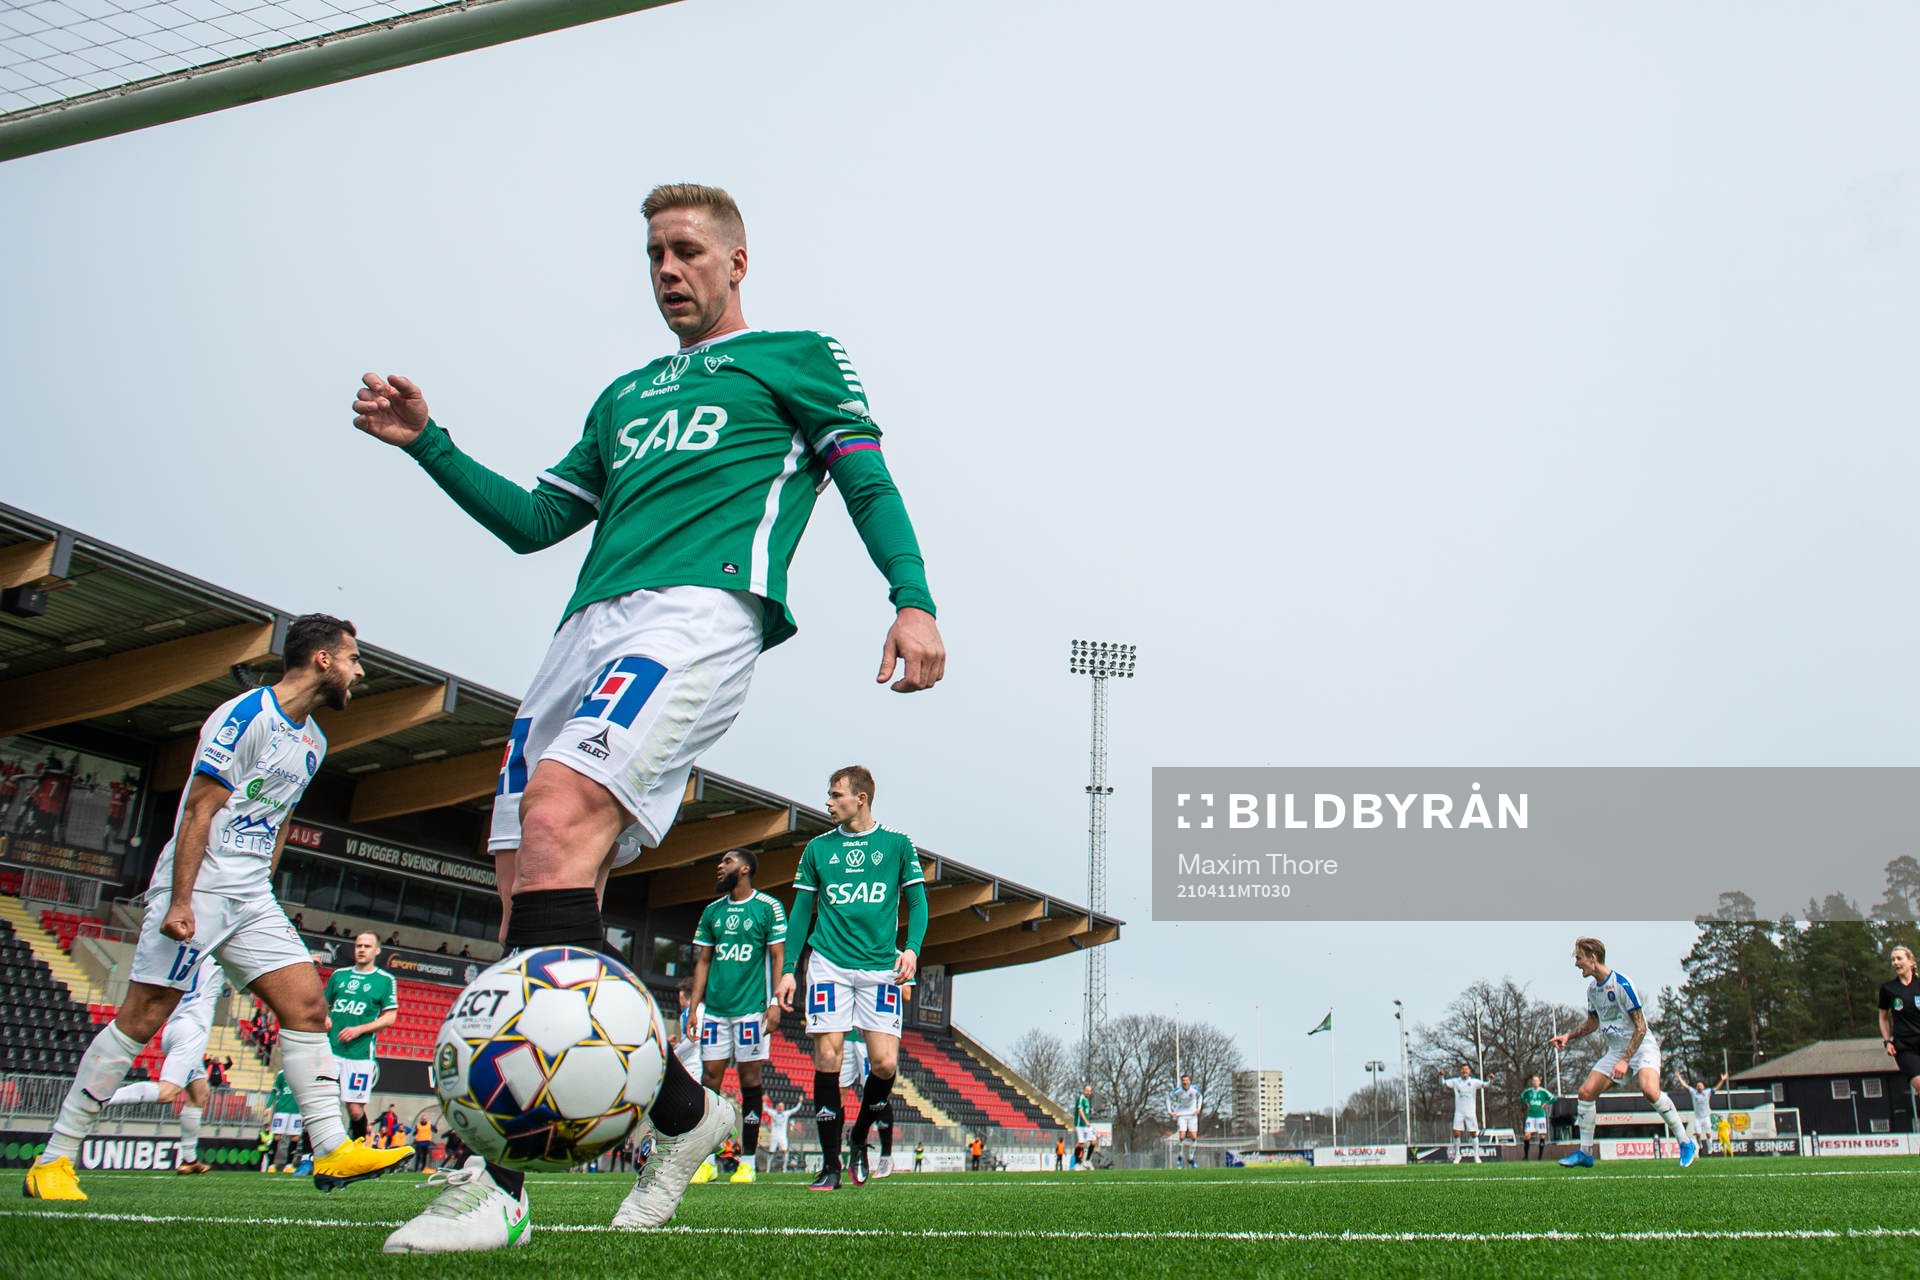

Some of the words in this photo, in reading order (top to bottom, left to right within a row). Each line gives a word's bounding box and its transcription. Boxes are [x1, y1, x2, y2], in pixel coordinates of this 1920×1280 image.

[640, 384, 680, 399] Bilmetro
[612, 405, 728, 469] SAB
[577, 741, 610, 761] SELECT
[290, 828, 322, 846] AUS
[346, 838, 358, 855] VI
[358, 841, 400, 865] BYGGER
[400, 852, 440, 874] SVENSK
[826, 882, 887, 904] SSAB
[447, 989, 511, 1020] LECT
[1754, 1140, 1796, 1152] SERNEKE
[1865, 1139, 1899, 1147] BUSS
